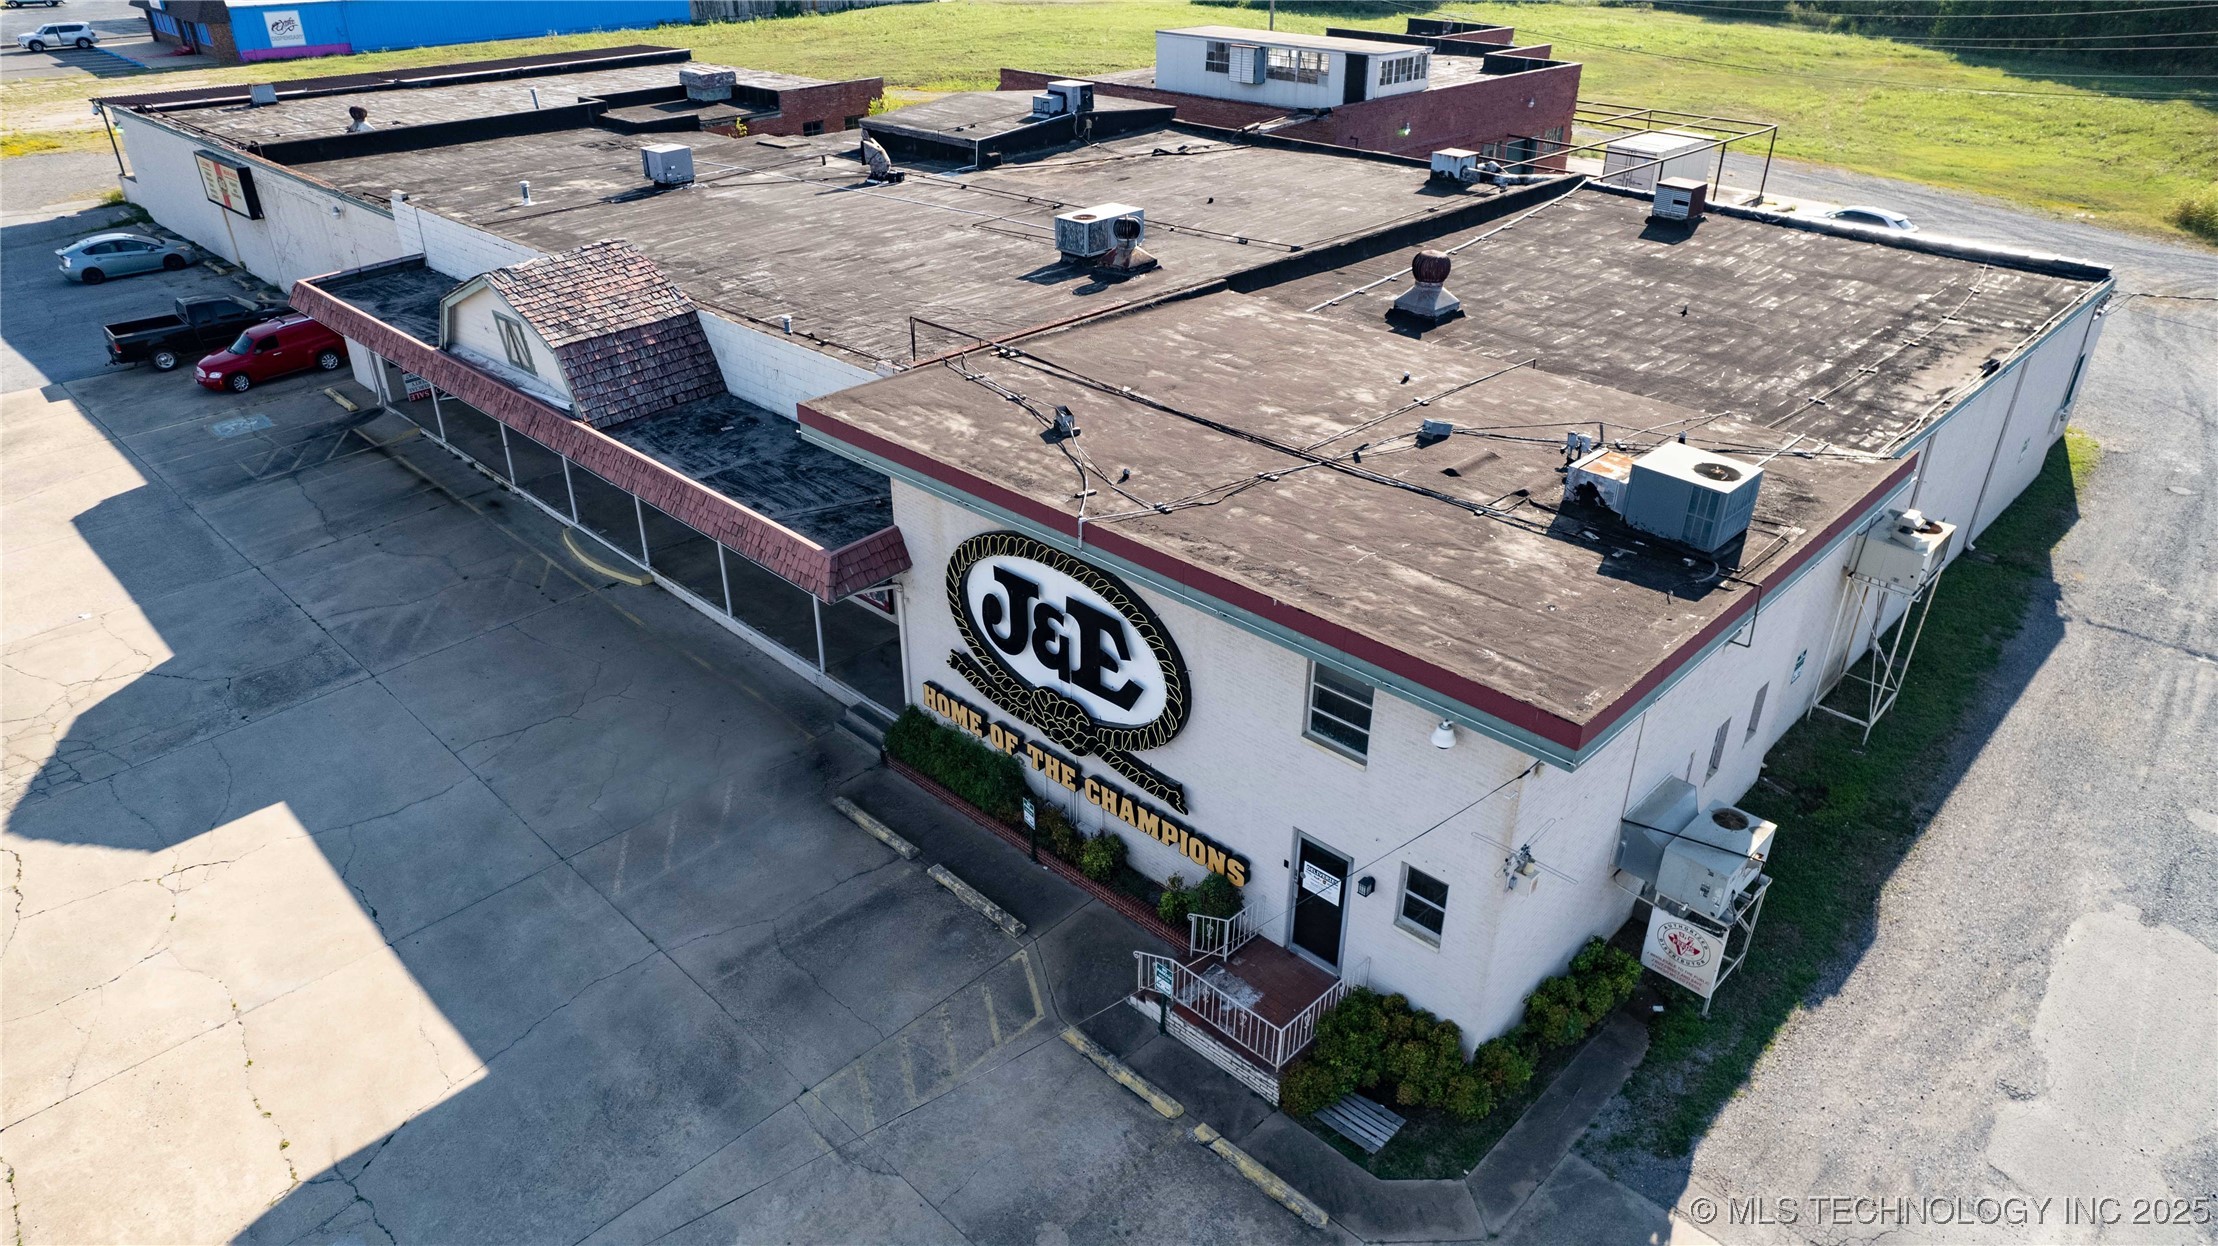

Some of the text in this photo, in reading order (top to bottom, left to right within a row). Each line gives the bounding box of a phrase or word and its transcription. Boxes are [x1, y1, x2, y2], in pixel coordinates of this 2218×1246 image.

[410, 391, 430, 401] SALE
[982, 565, 1144, 712] J&E
[922, 682, 986, 739] HOME
[990, 722, 1022, 756] OF
[1027, 742, 1080, 793] THE
[1084, 776, 1247, 888] CHAMPIONS
[1663, 924, 1709, 951] AUTHORIZED
[1659, 938, 1705, 966] DISTRIBUTOR
